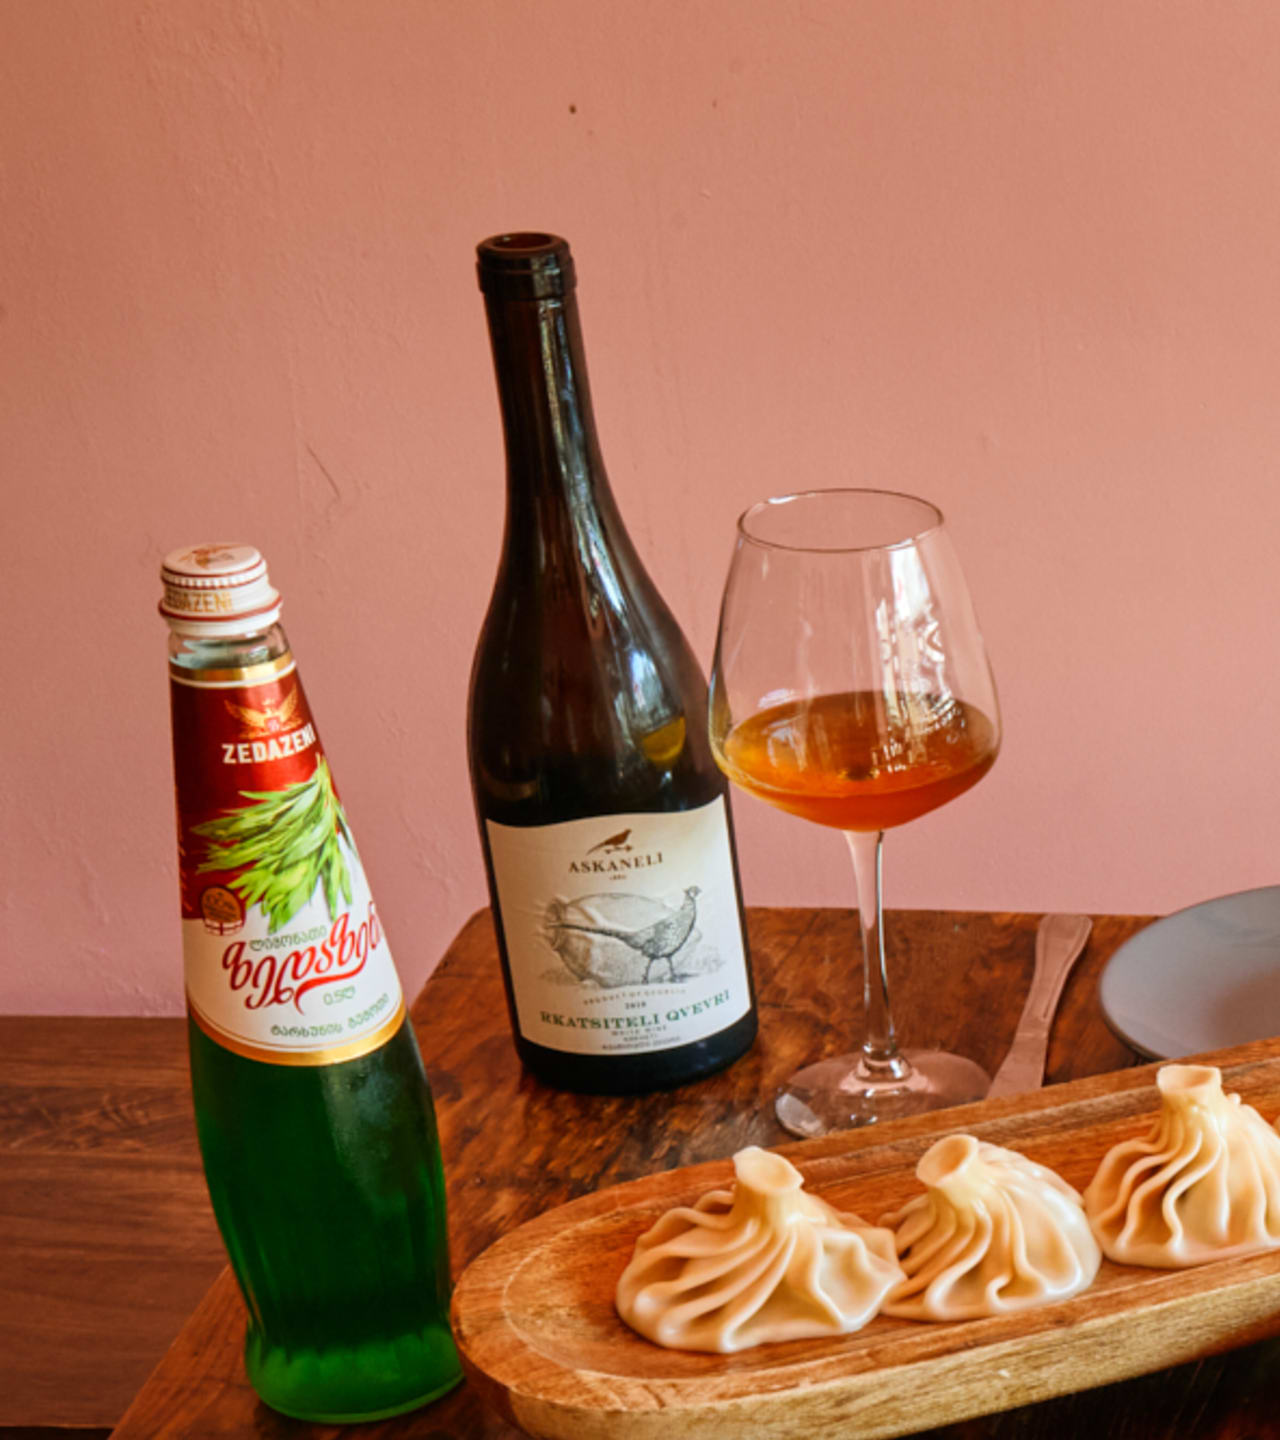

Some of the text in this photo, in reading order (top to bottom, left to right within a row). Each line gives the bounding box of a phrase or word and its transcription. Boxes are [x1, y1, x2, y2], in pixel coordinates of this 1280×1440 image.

[567, 852, 663, 873] ASKANELI
[540, 989, 730, 1029] RKATSITELI QVEVRI
